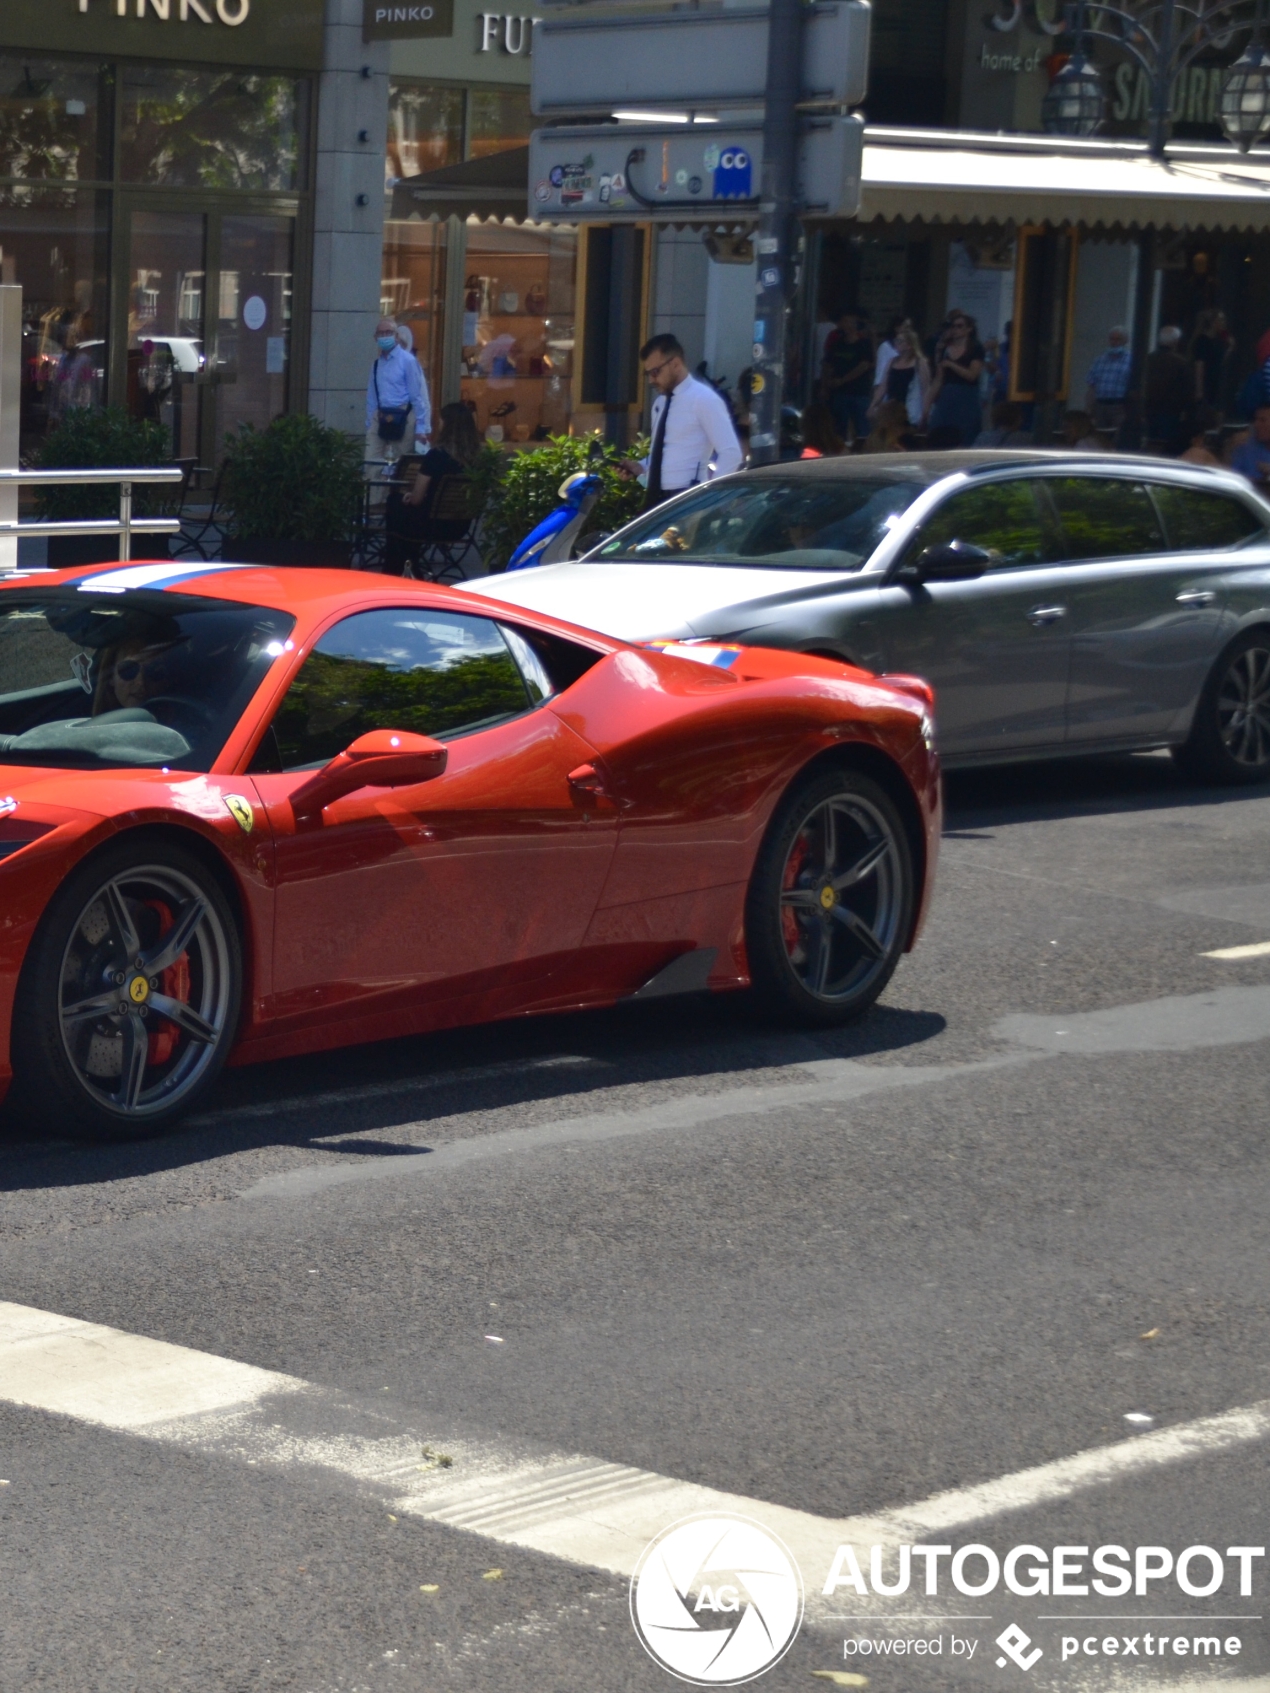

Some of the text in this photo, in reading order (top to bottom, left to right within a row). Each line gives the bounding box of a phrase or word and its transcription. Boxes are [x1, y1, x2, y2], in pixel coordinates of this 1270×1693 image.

[375, 6, 434, 23] PINKO
[482, 13, 541, 54] FU
[981, 43, 1041, 73] home of
